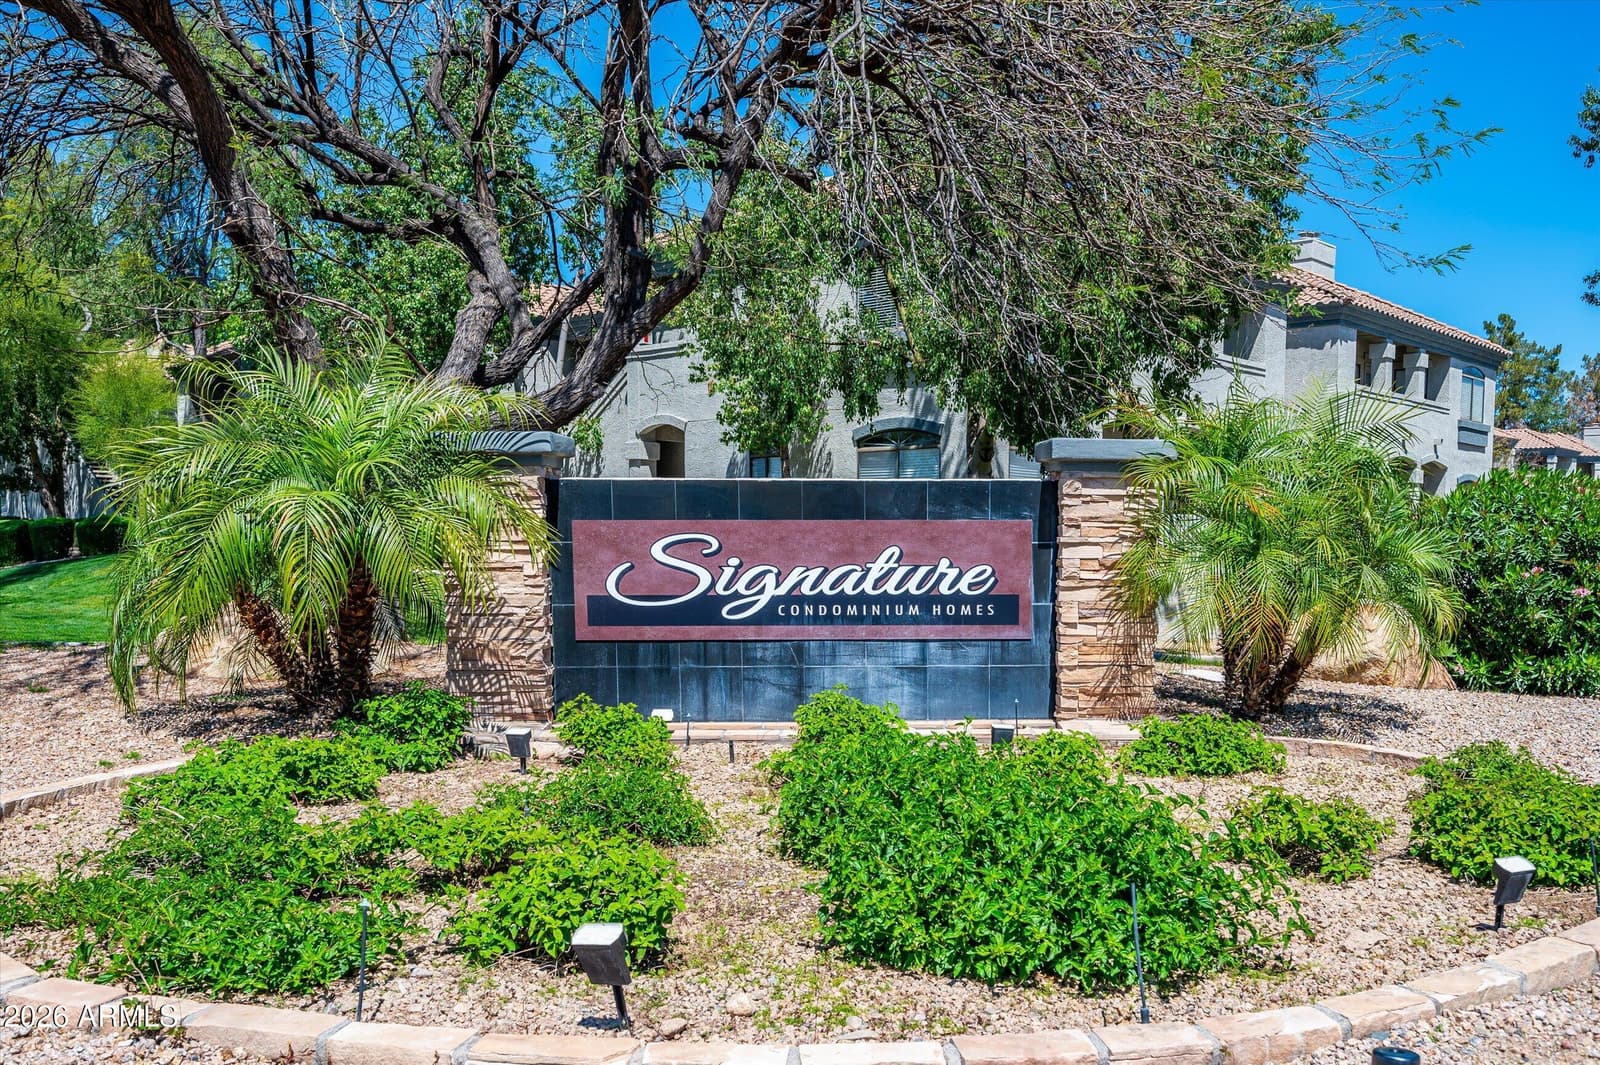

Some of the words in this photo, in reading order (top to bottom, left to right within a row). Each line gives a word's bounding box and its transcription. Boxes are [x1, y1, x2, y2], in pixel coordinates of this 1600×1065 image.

[605, 532, 996, 620] Signature
[777, 604, 921, 616] CONDOMINIUM
[932, 604, 996, 616] HOMES
